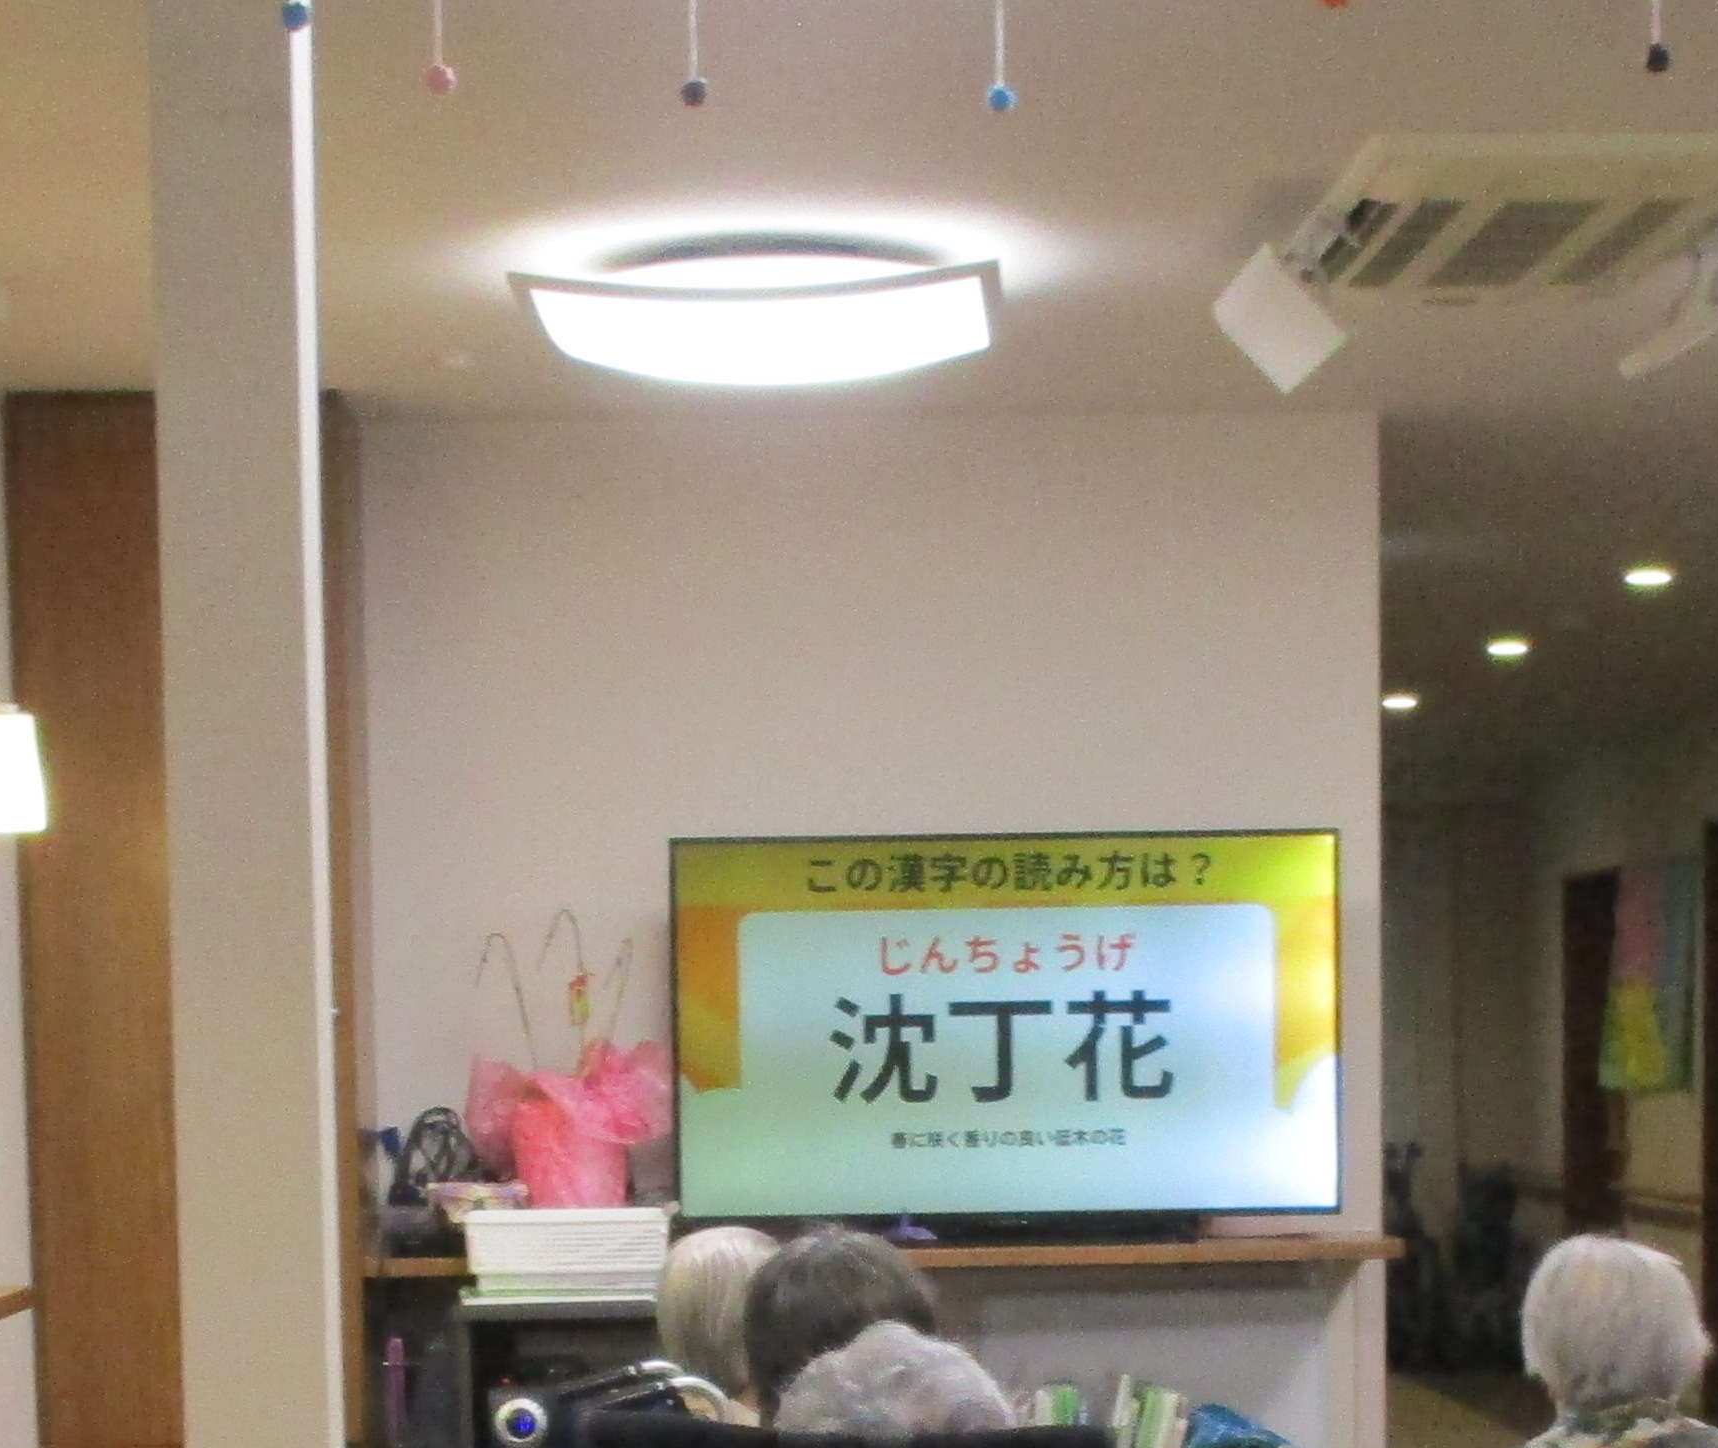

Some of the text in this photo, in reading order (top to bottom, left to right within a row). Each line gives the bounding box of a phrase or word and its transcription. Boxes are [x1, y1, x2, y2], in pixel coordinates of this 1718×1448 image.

[808, 852, 1213, 893] この漢字の読み方は？
[879, 934, 1136, 975] じんちょうげ
[829, 990, 1174, 1103] 沈丁花
